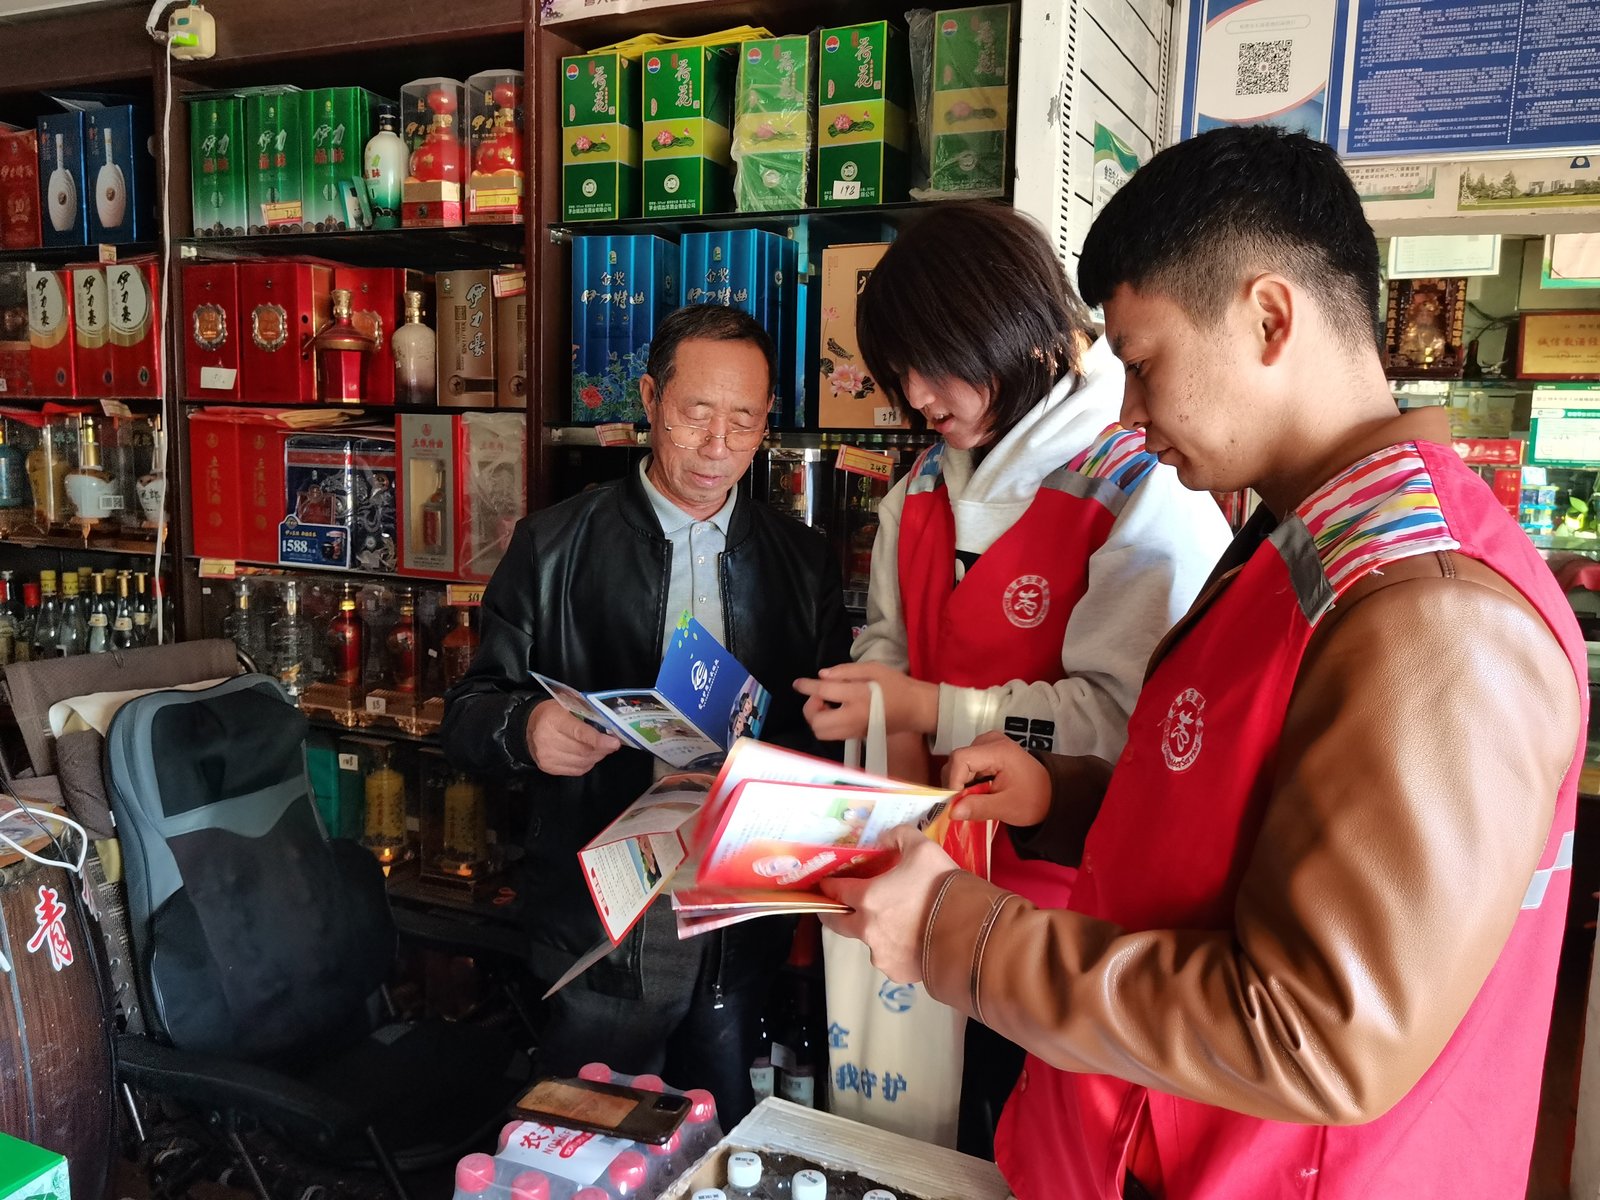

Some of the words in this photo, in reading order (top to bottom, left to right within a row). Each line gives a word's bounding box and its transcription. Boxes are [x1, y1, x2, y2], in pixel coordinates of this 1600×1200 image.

[675, 59, 692, 107] 荷花
[854, 37, 873, 88] 荷花
[592, 66, 608, 112] 荷花
[117, 270, 131, 323] 伊力豪
[600, 271, 625, 287] 金奖
[687, 286, 748, 307] 伊力特曲
[704, 267, 730, 284] 金奖
[36, 277, 50, 327] 伊力豪
[83, 275, 96, 326] 伊力豪
[466, 283, 487, 357] 伊力豪
[580, 289, 645, 309] 伊力特曲
[870, 463, 888, 474] 248
[282, 539, 309, 553] 1588
